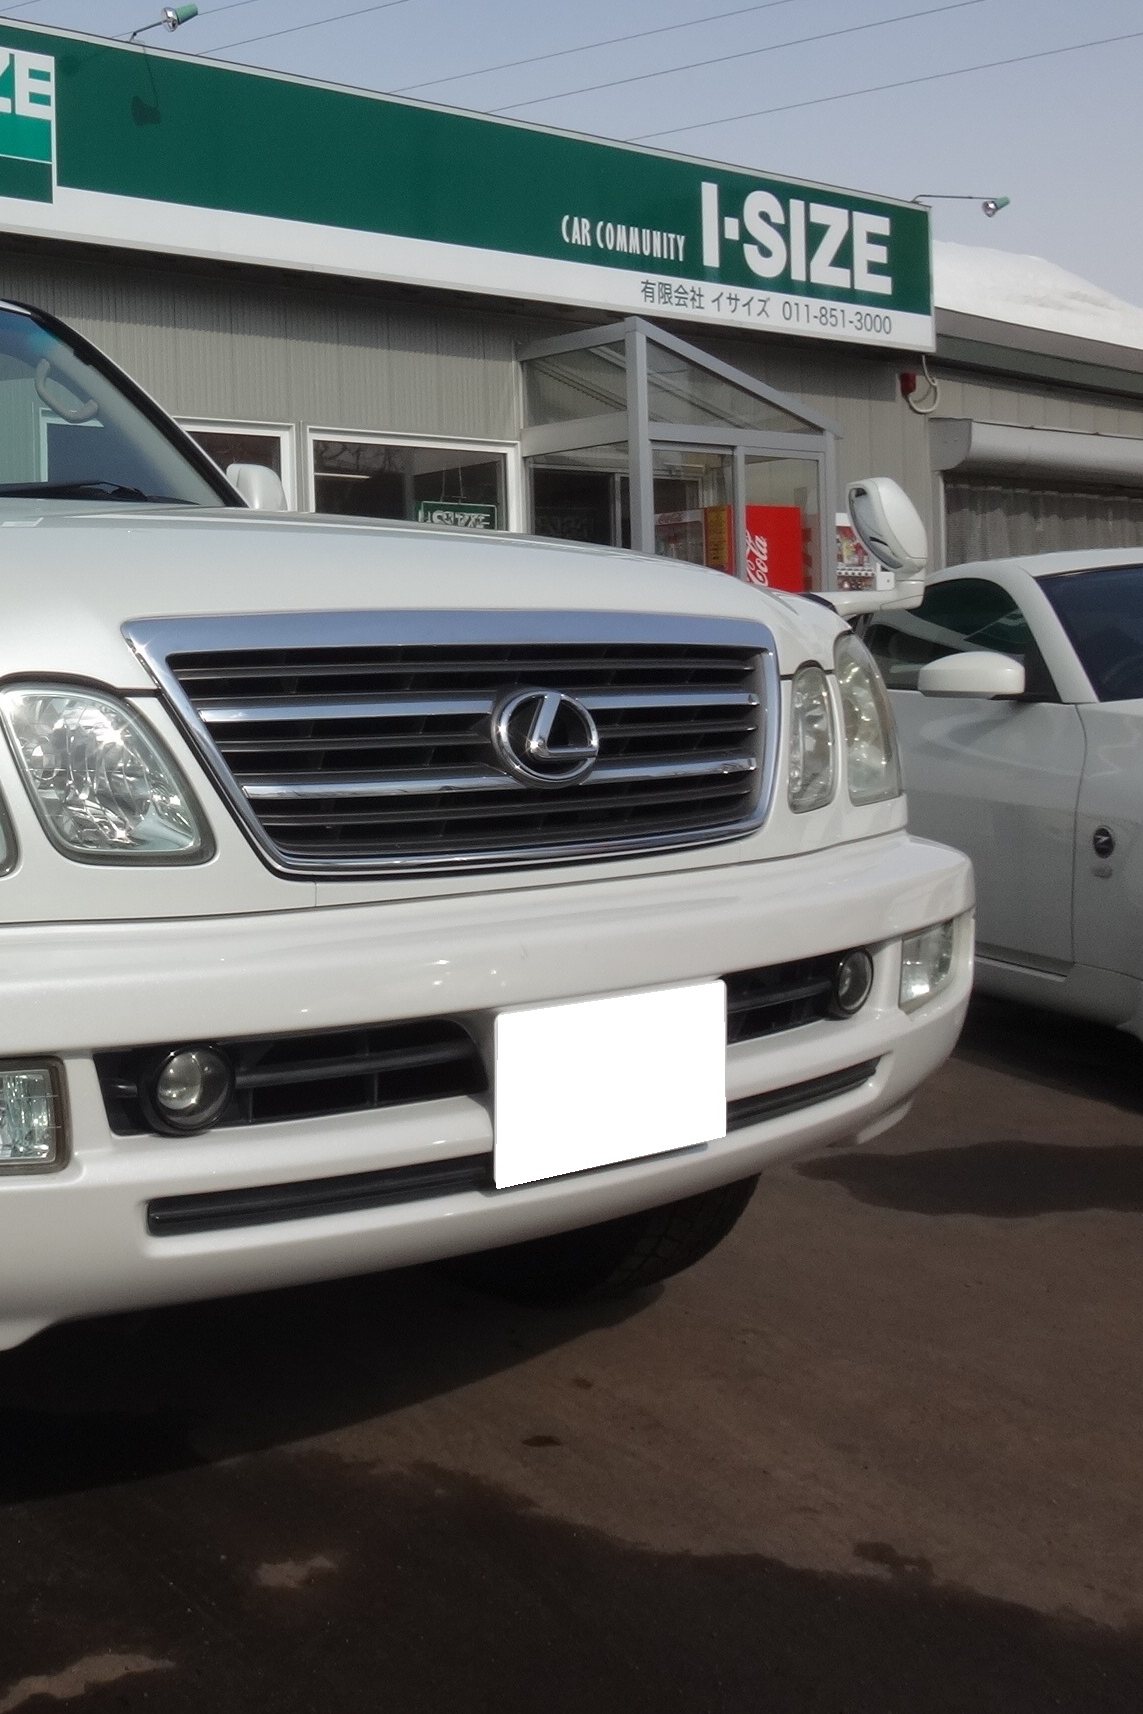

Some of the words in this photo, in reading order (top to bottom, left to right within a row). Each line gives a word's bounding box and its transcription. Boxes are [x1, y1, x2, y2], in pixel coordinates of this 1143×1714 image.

[561, 214, 592, 247] CAR
[596, 220, 685, 262] COMMUNITY
[640, 279, 705, 310] 有限会社
[711, 291, 771, 318] イサイズ
[782, 301, 893, 335] 011-851-3000
